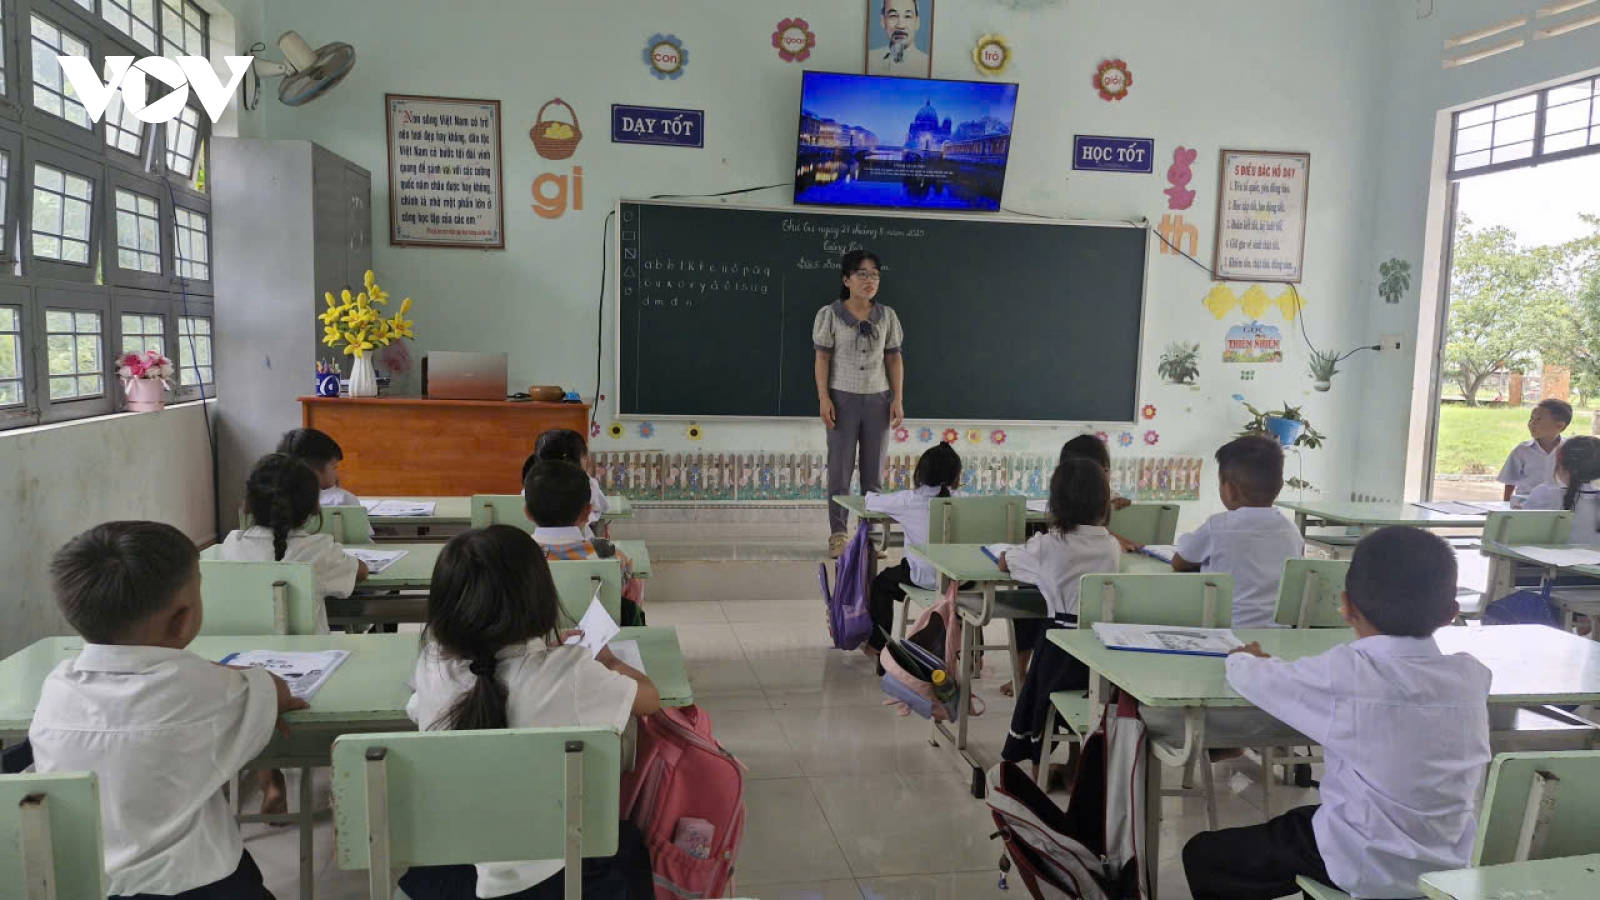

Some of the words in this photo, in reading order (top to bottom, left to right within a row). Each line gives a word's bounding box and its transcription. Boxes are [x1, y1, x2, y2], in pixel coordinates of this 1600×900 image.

[455, 114, 468, 127] Nam
[622, 117, 656, 136] DẠY
[661, 114, 693, 136] TỐT
[414, 146, 428, 157] Nam
[1082, 145, 1112, 164] HỌC
[1117, 142, 1145, 162] TỐT
[530, 165, 583, 219] gi
[1158, 214, 1198, 256] th
